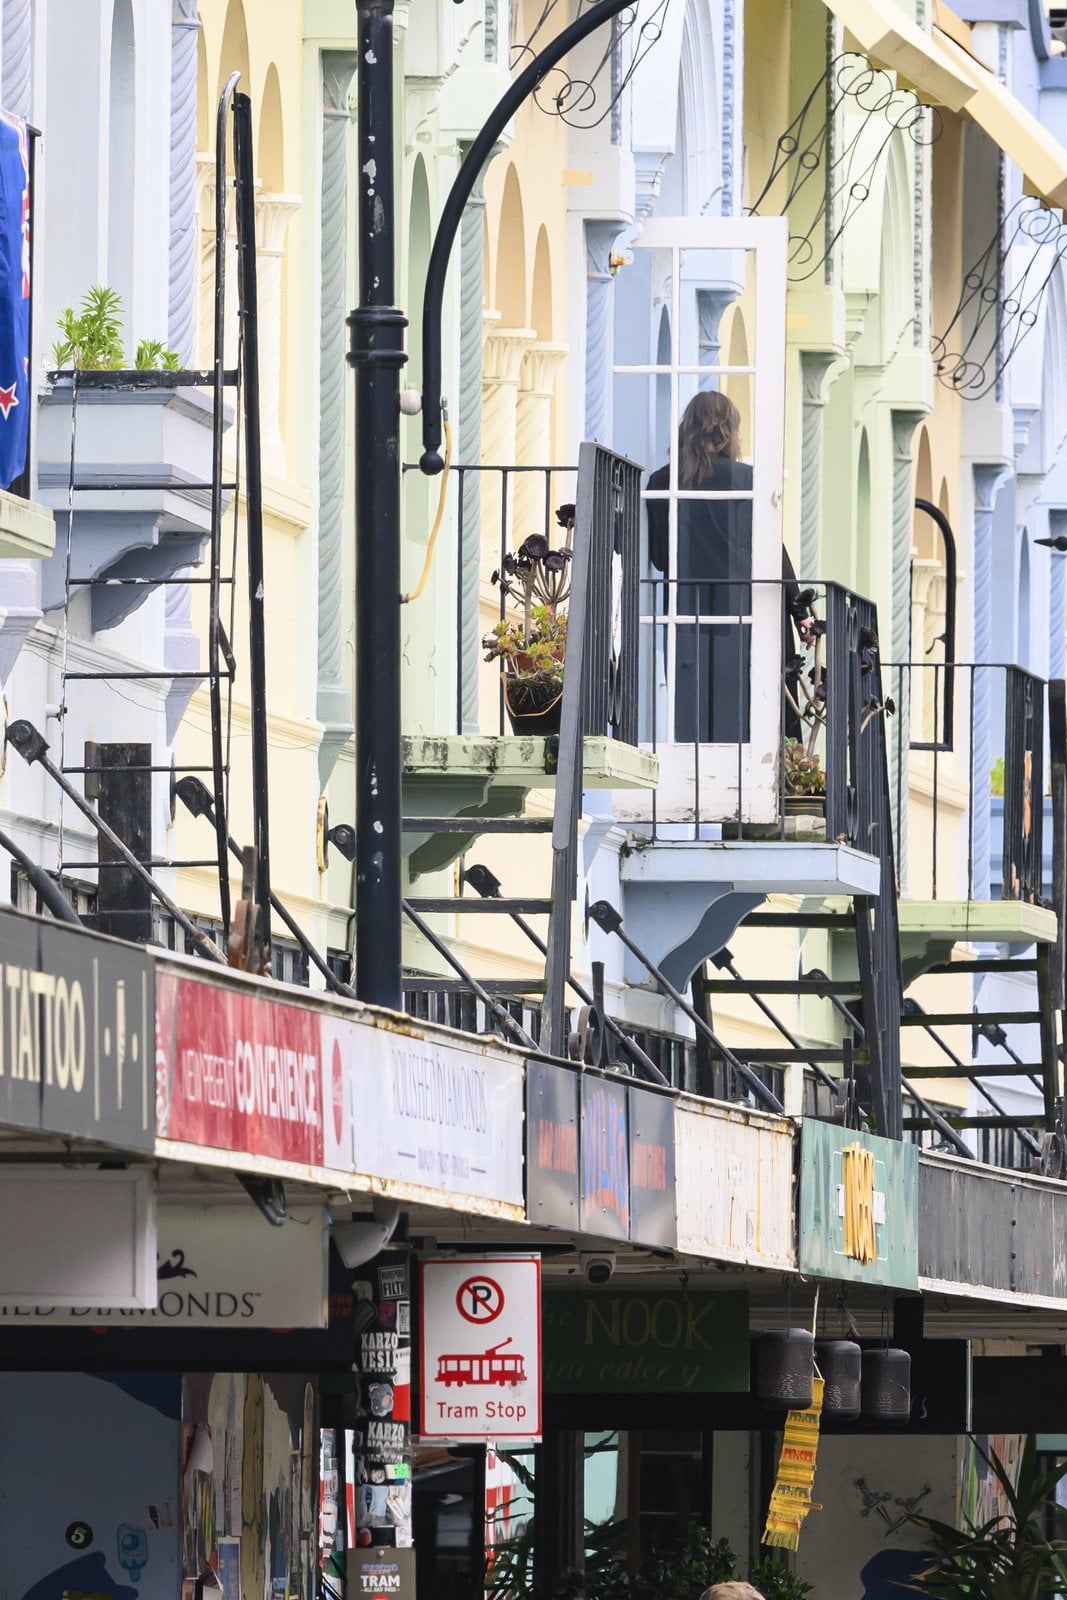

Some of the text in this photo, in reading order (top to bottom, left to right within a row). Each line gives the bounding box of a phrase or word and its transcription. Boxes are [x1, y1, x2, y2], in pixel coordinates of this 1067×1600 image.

[5, 963, 86, 1093] TATTOO
[234, 1038, 318, 1126] CONVENIENCE
[584, 1298, 718, 1351] NOOK
[437, 1401, 527, 1422] Tram Stop
[360, 1575, 401, 1588] TRAM
